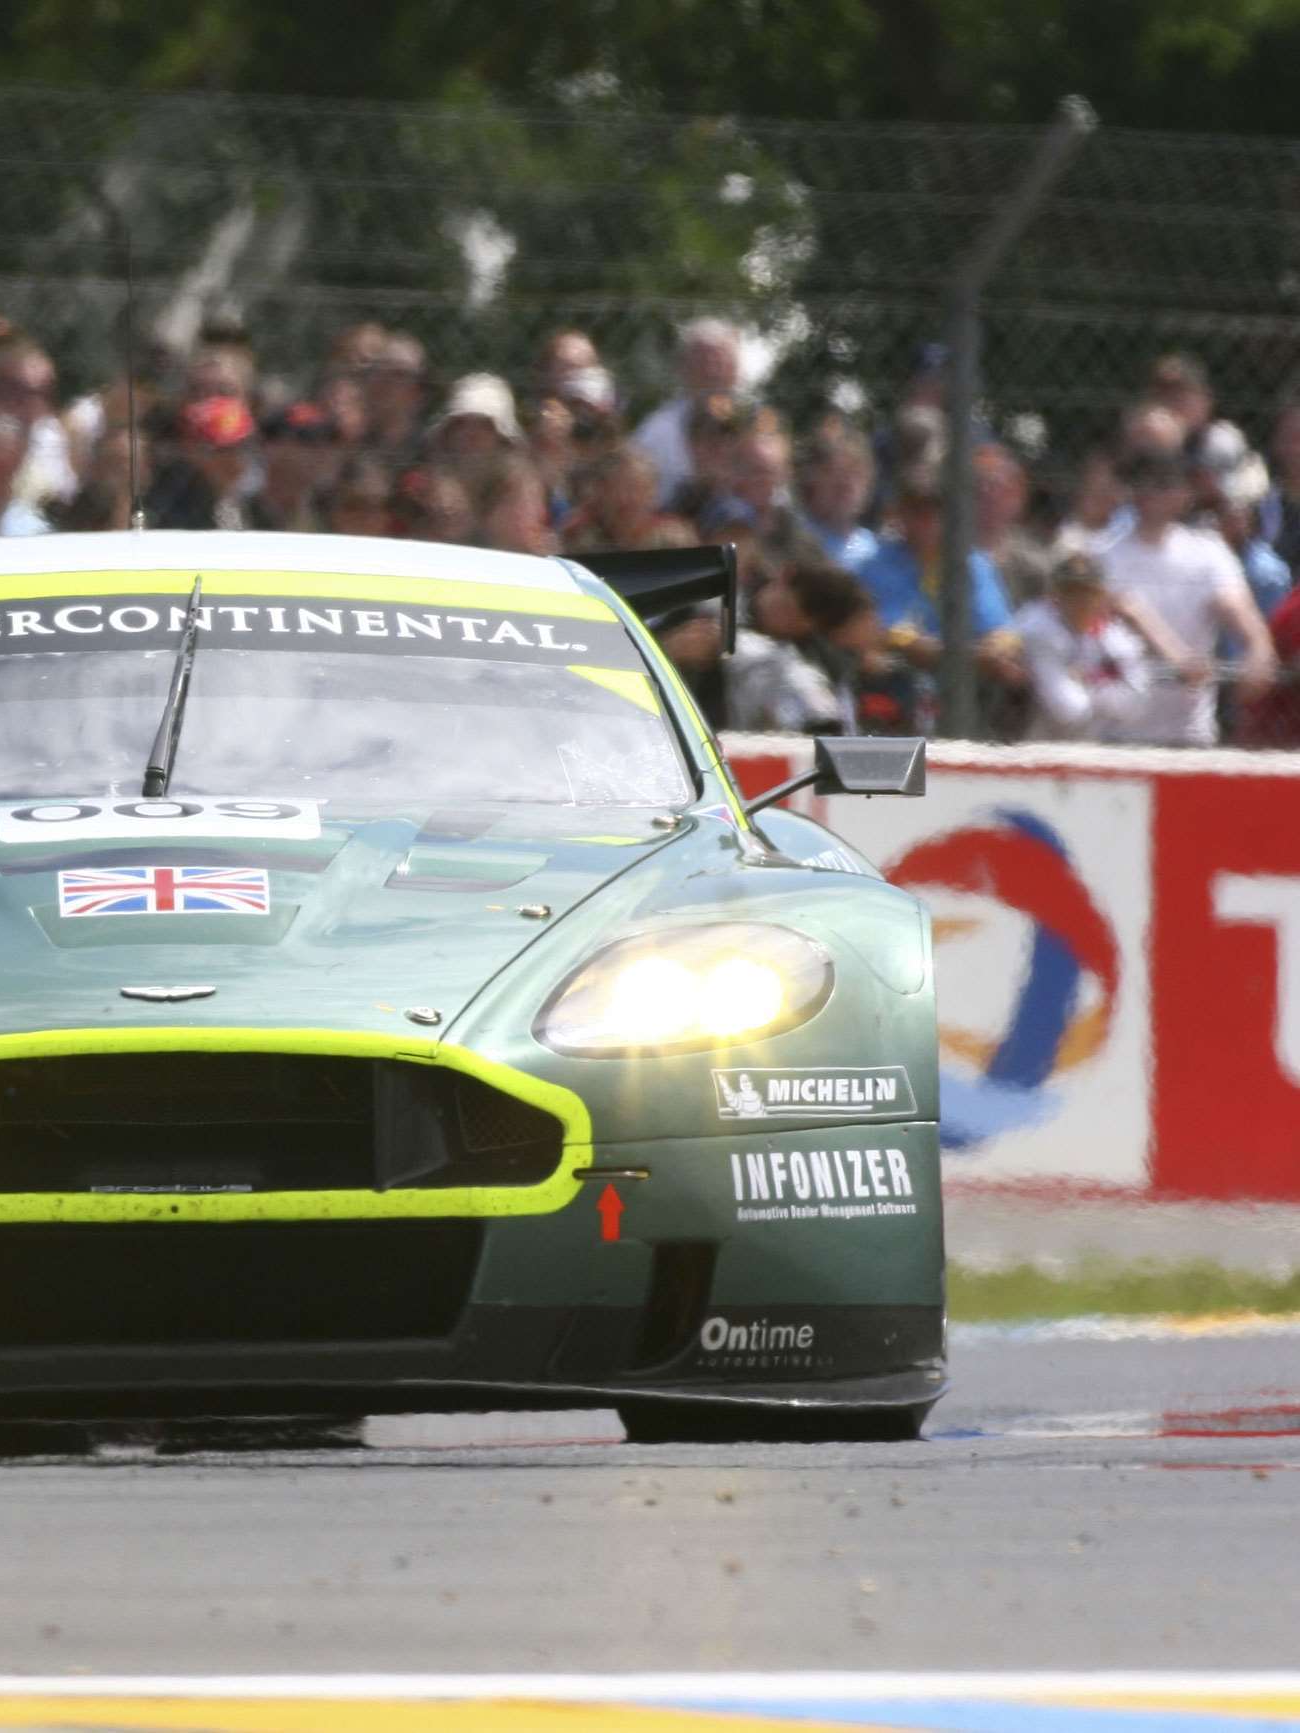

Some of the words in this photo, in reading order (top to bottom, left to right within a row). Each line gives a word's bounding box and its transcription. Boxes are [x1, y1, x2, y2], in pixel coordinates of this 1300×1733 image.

[11, 802, 302, 822] 009
[767, 1078, 897, 1102] MICHELIN
[731, 1149, 913, 1201] INFONIZER
[701, 1316, 814, 1351] Ontime
